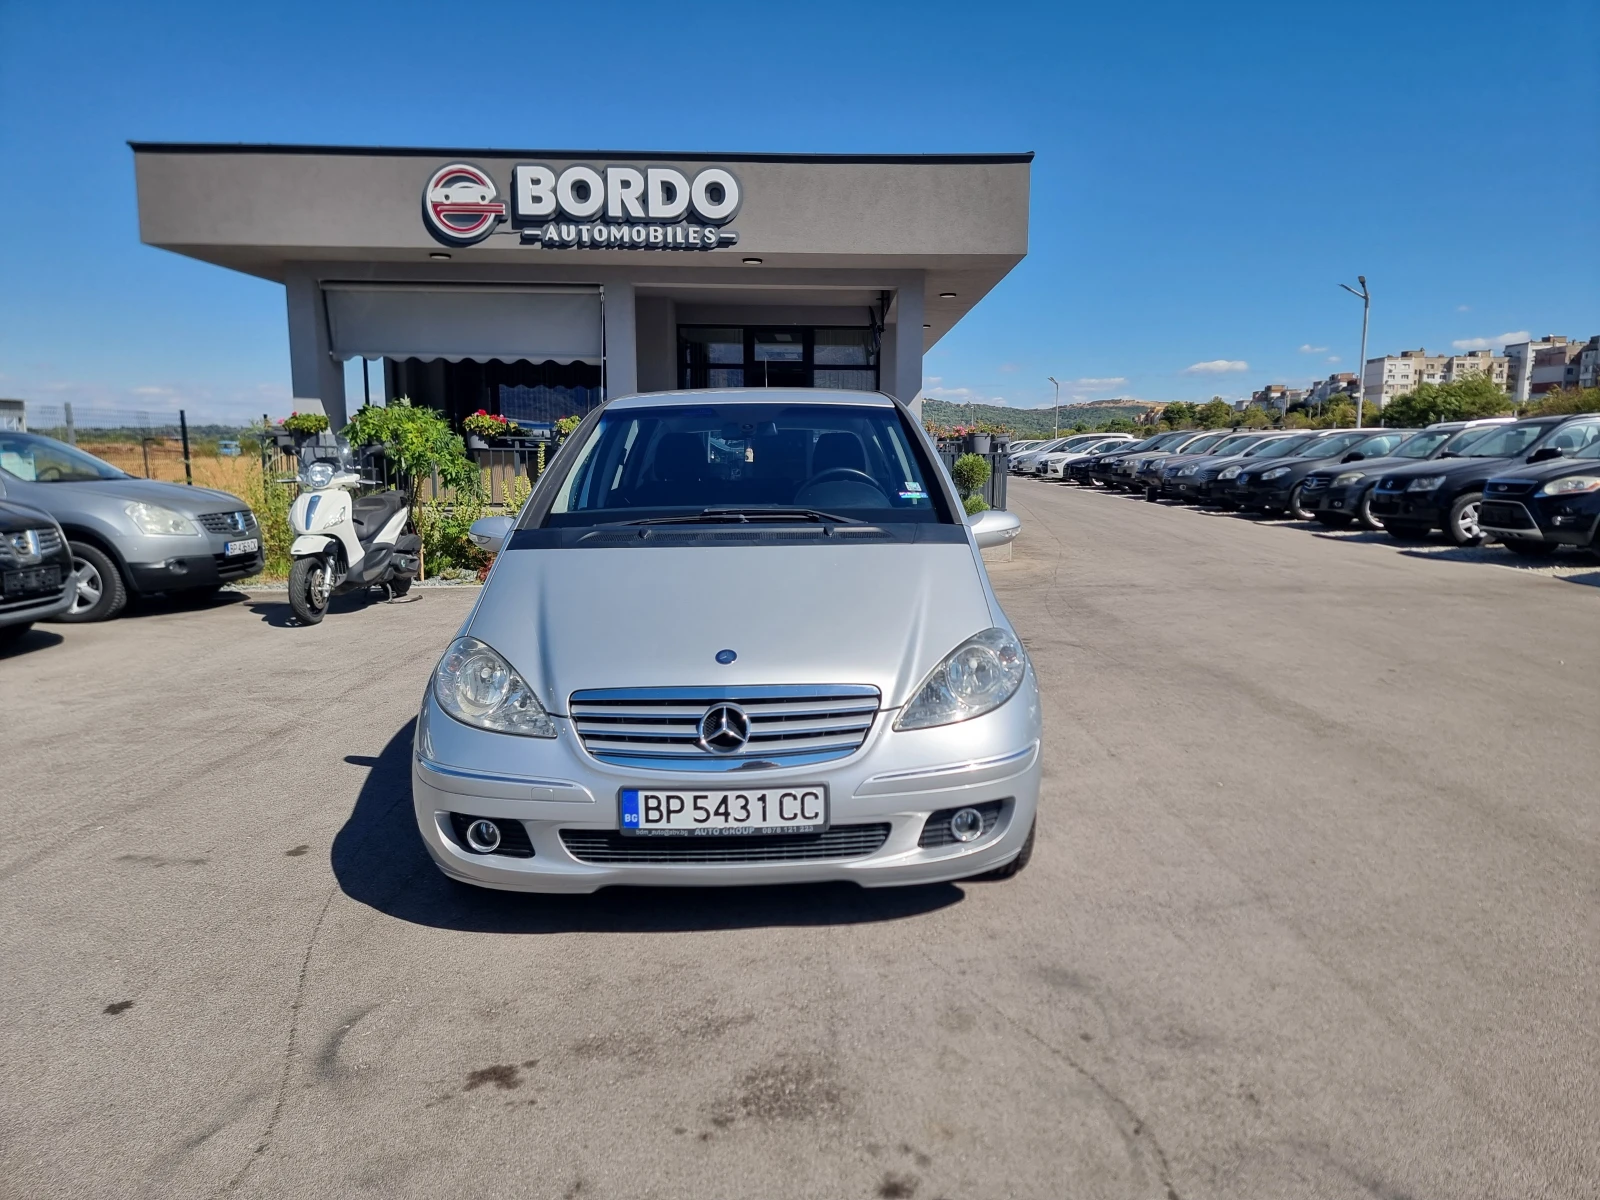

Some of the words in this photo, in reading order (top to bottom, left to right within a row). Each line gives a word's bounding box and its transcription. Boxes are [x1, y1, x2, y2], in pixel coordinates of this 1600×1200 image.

[516, 166, 739, 218] BORDO
[545, 226, 716, 243] AUTOMOBILES
[644, 795, 685, 824] BP
[693, 793, 767, 824] 5431
[779, 792, 819, 821] CC
[624, 813, 638, 823] BG
[694, 827, 720, 836] AUTO
[722, 826, 755, 836] GROUP
